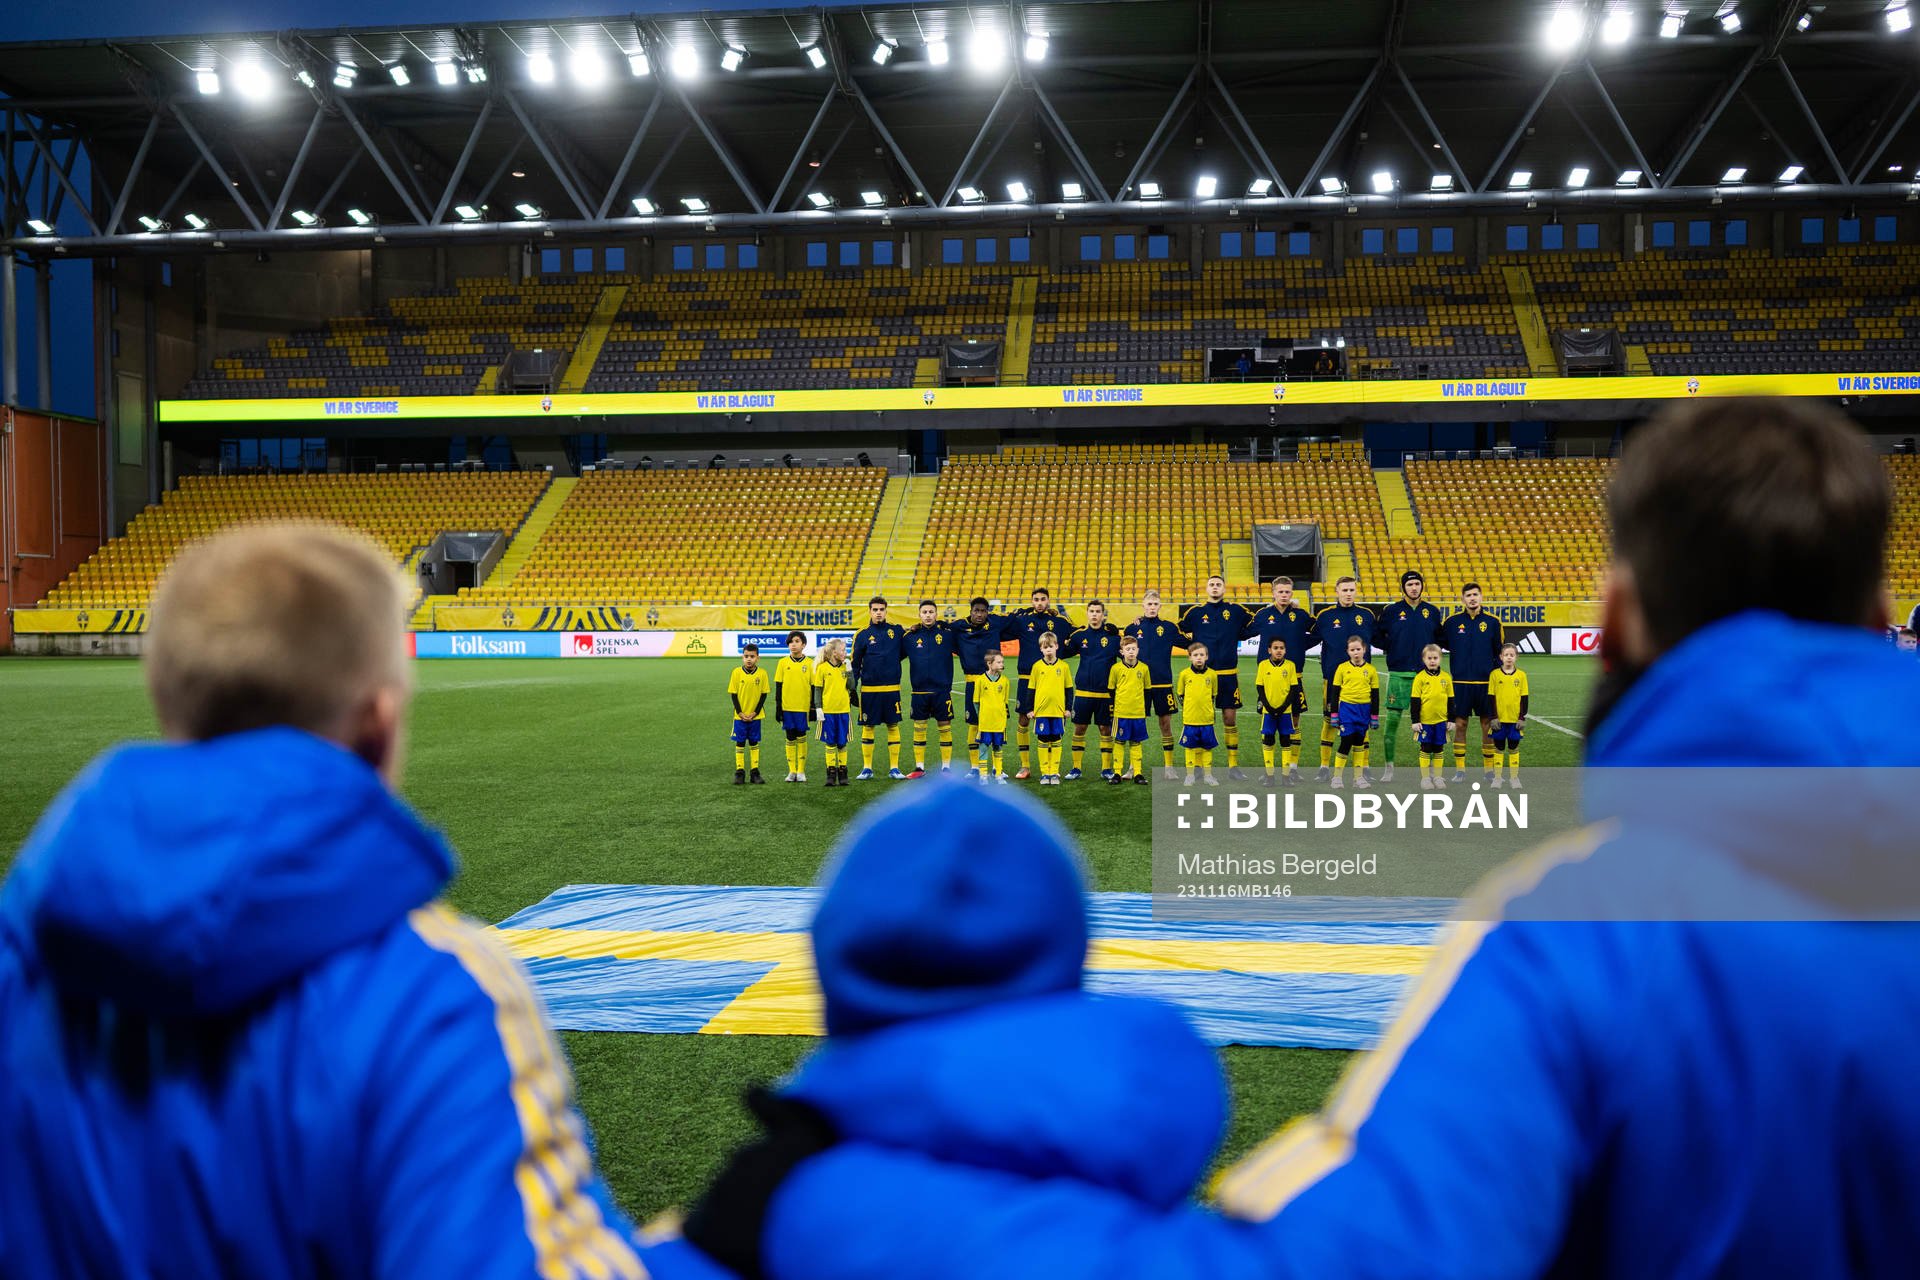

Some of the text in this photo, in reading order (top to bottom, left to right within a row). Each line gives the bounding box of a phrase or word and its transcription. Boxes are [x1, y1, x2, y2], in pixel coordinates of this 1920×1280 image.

[1442, 382, 1526, 396] VI ÄR BLÅGULT
[1838, 376, 1920, 390] VI ÄR SVERIG
[697, 394, 775, 408] VI ÄR BLÅGULT
[1063, 388, 1143, 402] VI ÄR SVERIGE
[324, 402, 336, 414] VI
[354, 401, 399, 414] SVERIGE
[747, 608, 853, 626] HEJA SVERIGE!
[451, 635, 526, 655] Folksam
[596, 638, 640, 646] SVENSKA
[596, 646, 619, 655] SPEL
[945, 699, 953, 713] 7
[1167, 693, 1175, 706] 8
